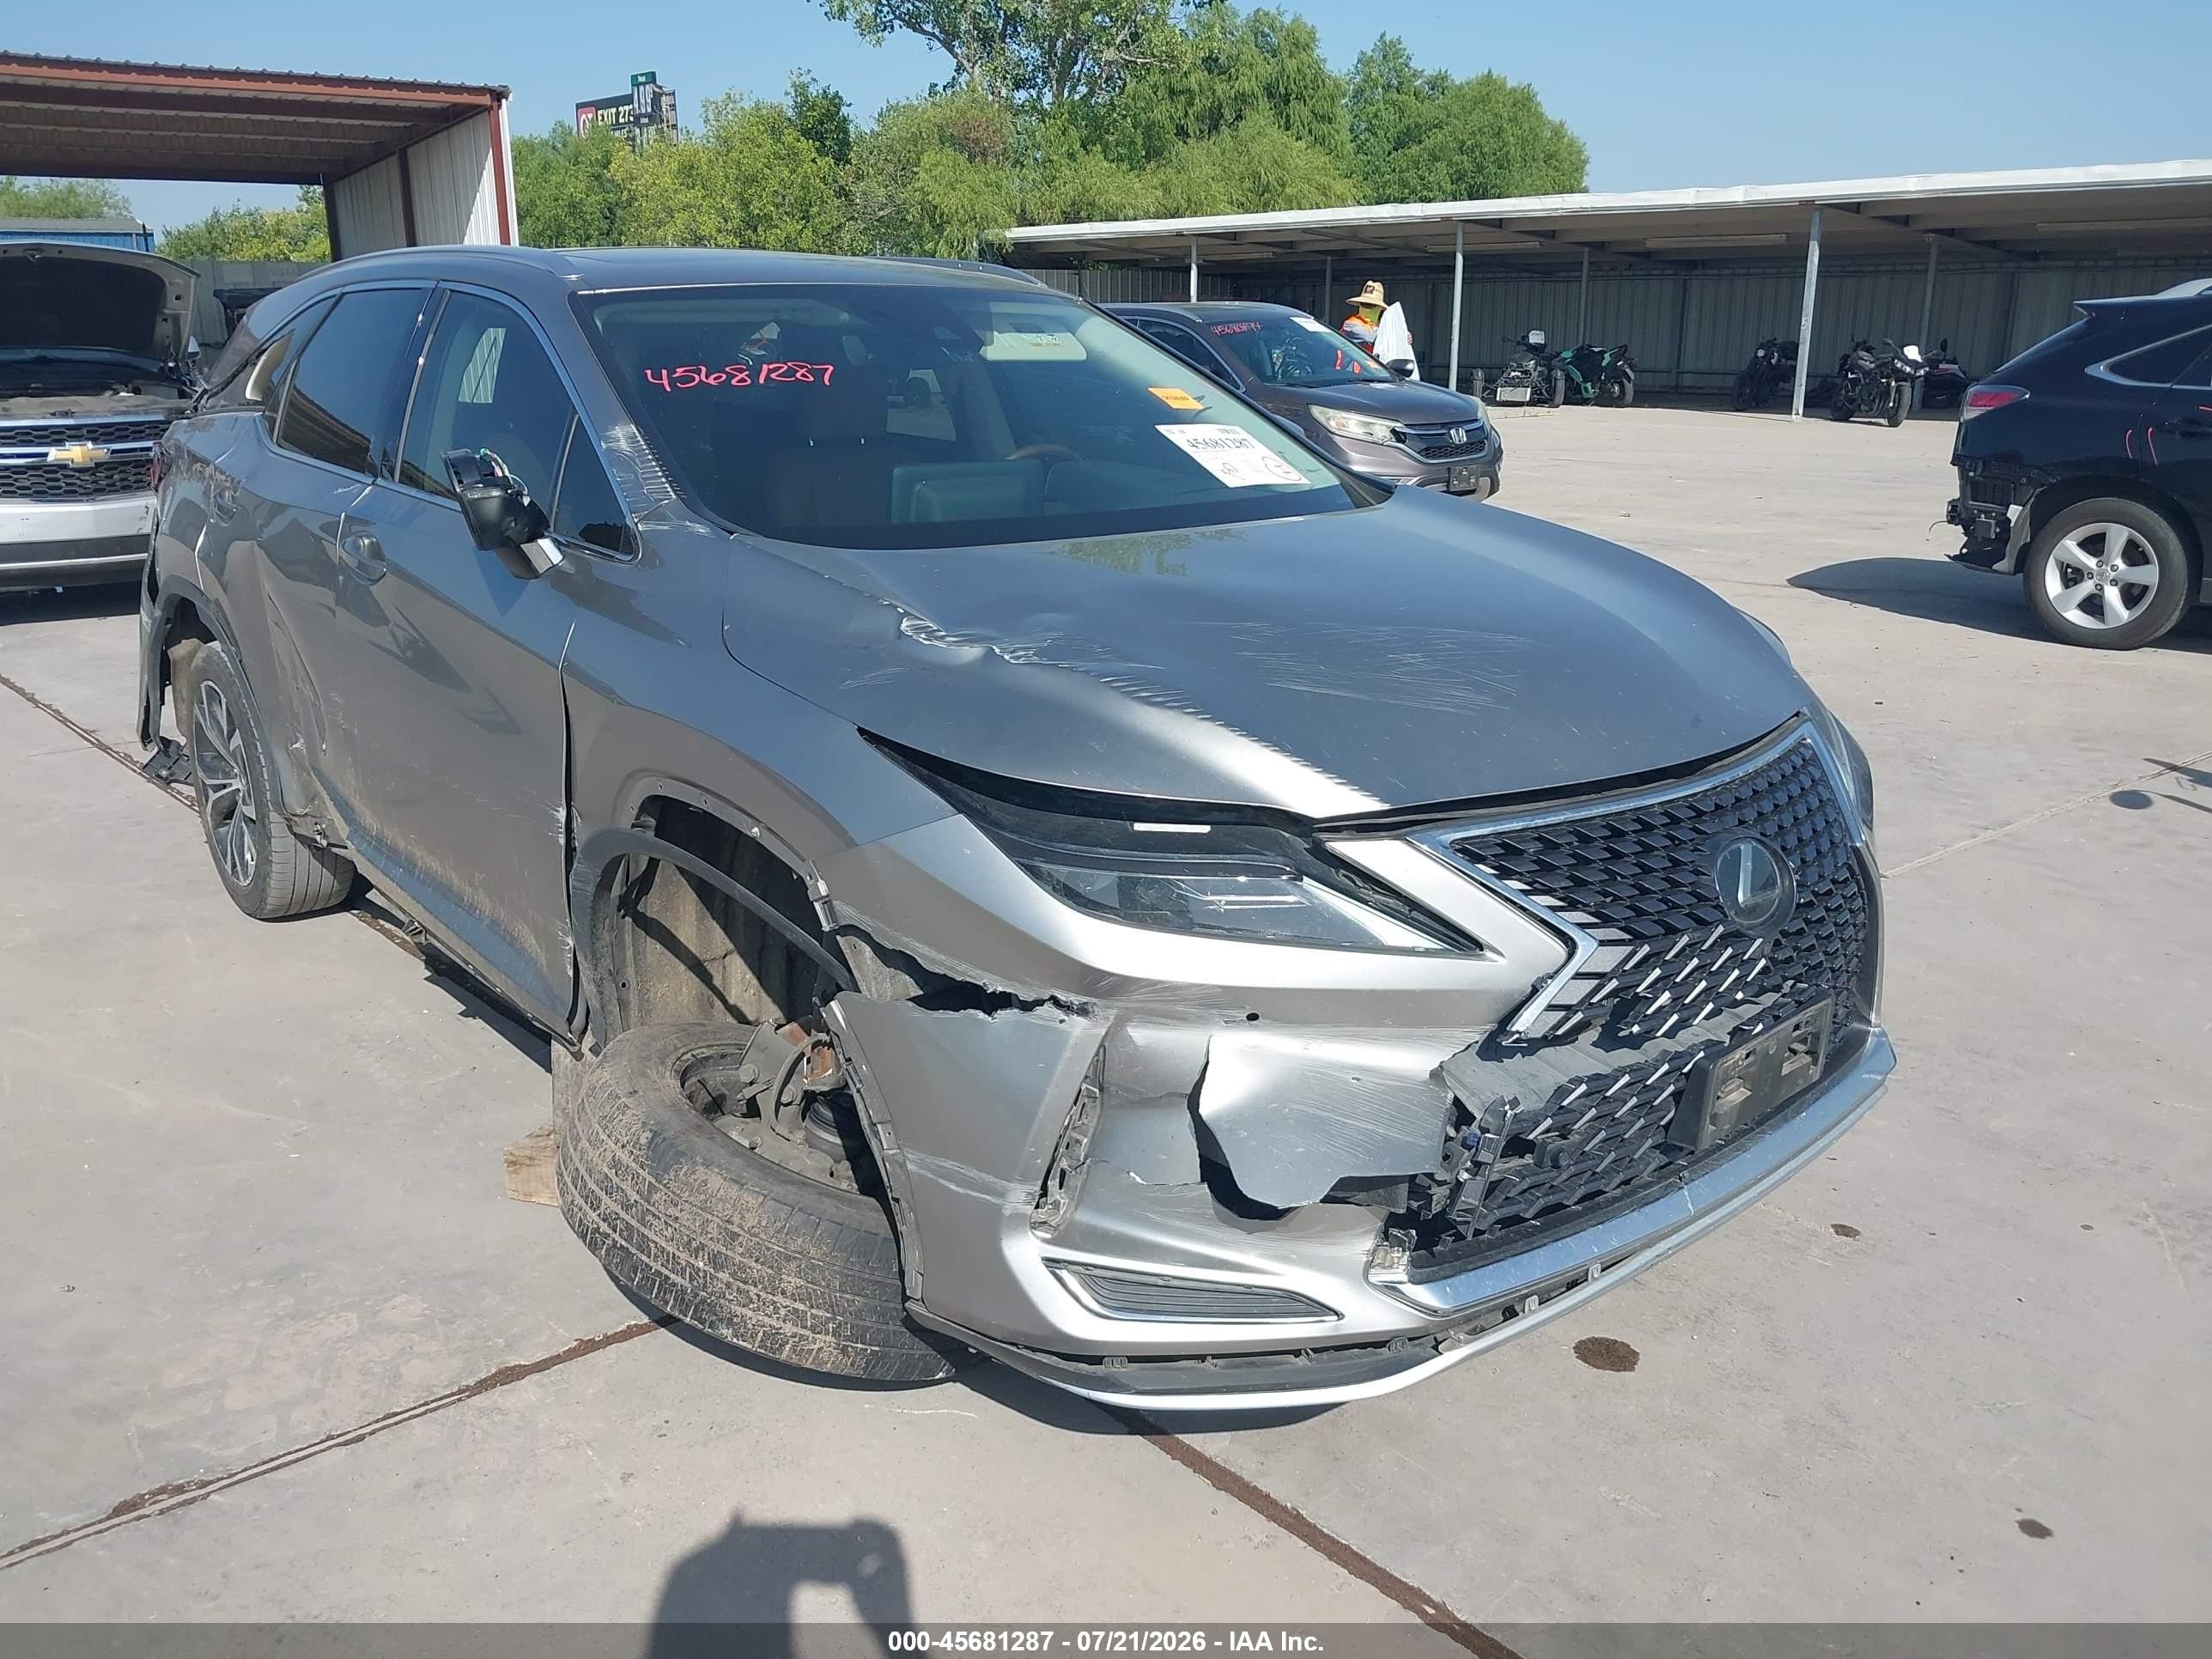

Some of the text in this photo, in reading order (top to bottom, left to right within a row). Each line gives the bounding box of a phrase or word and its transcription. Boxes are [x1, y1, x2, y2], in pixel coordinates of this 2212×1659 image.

[598, 106, 617, 126] EXIT
[645, 362, 835, 392] 45681287
[1187, 437, 1255, 450] 45681287
